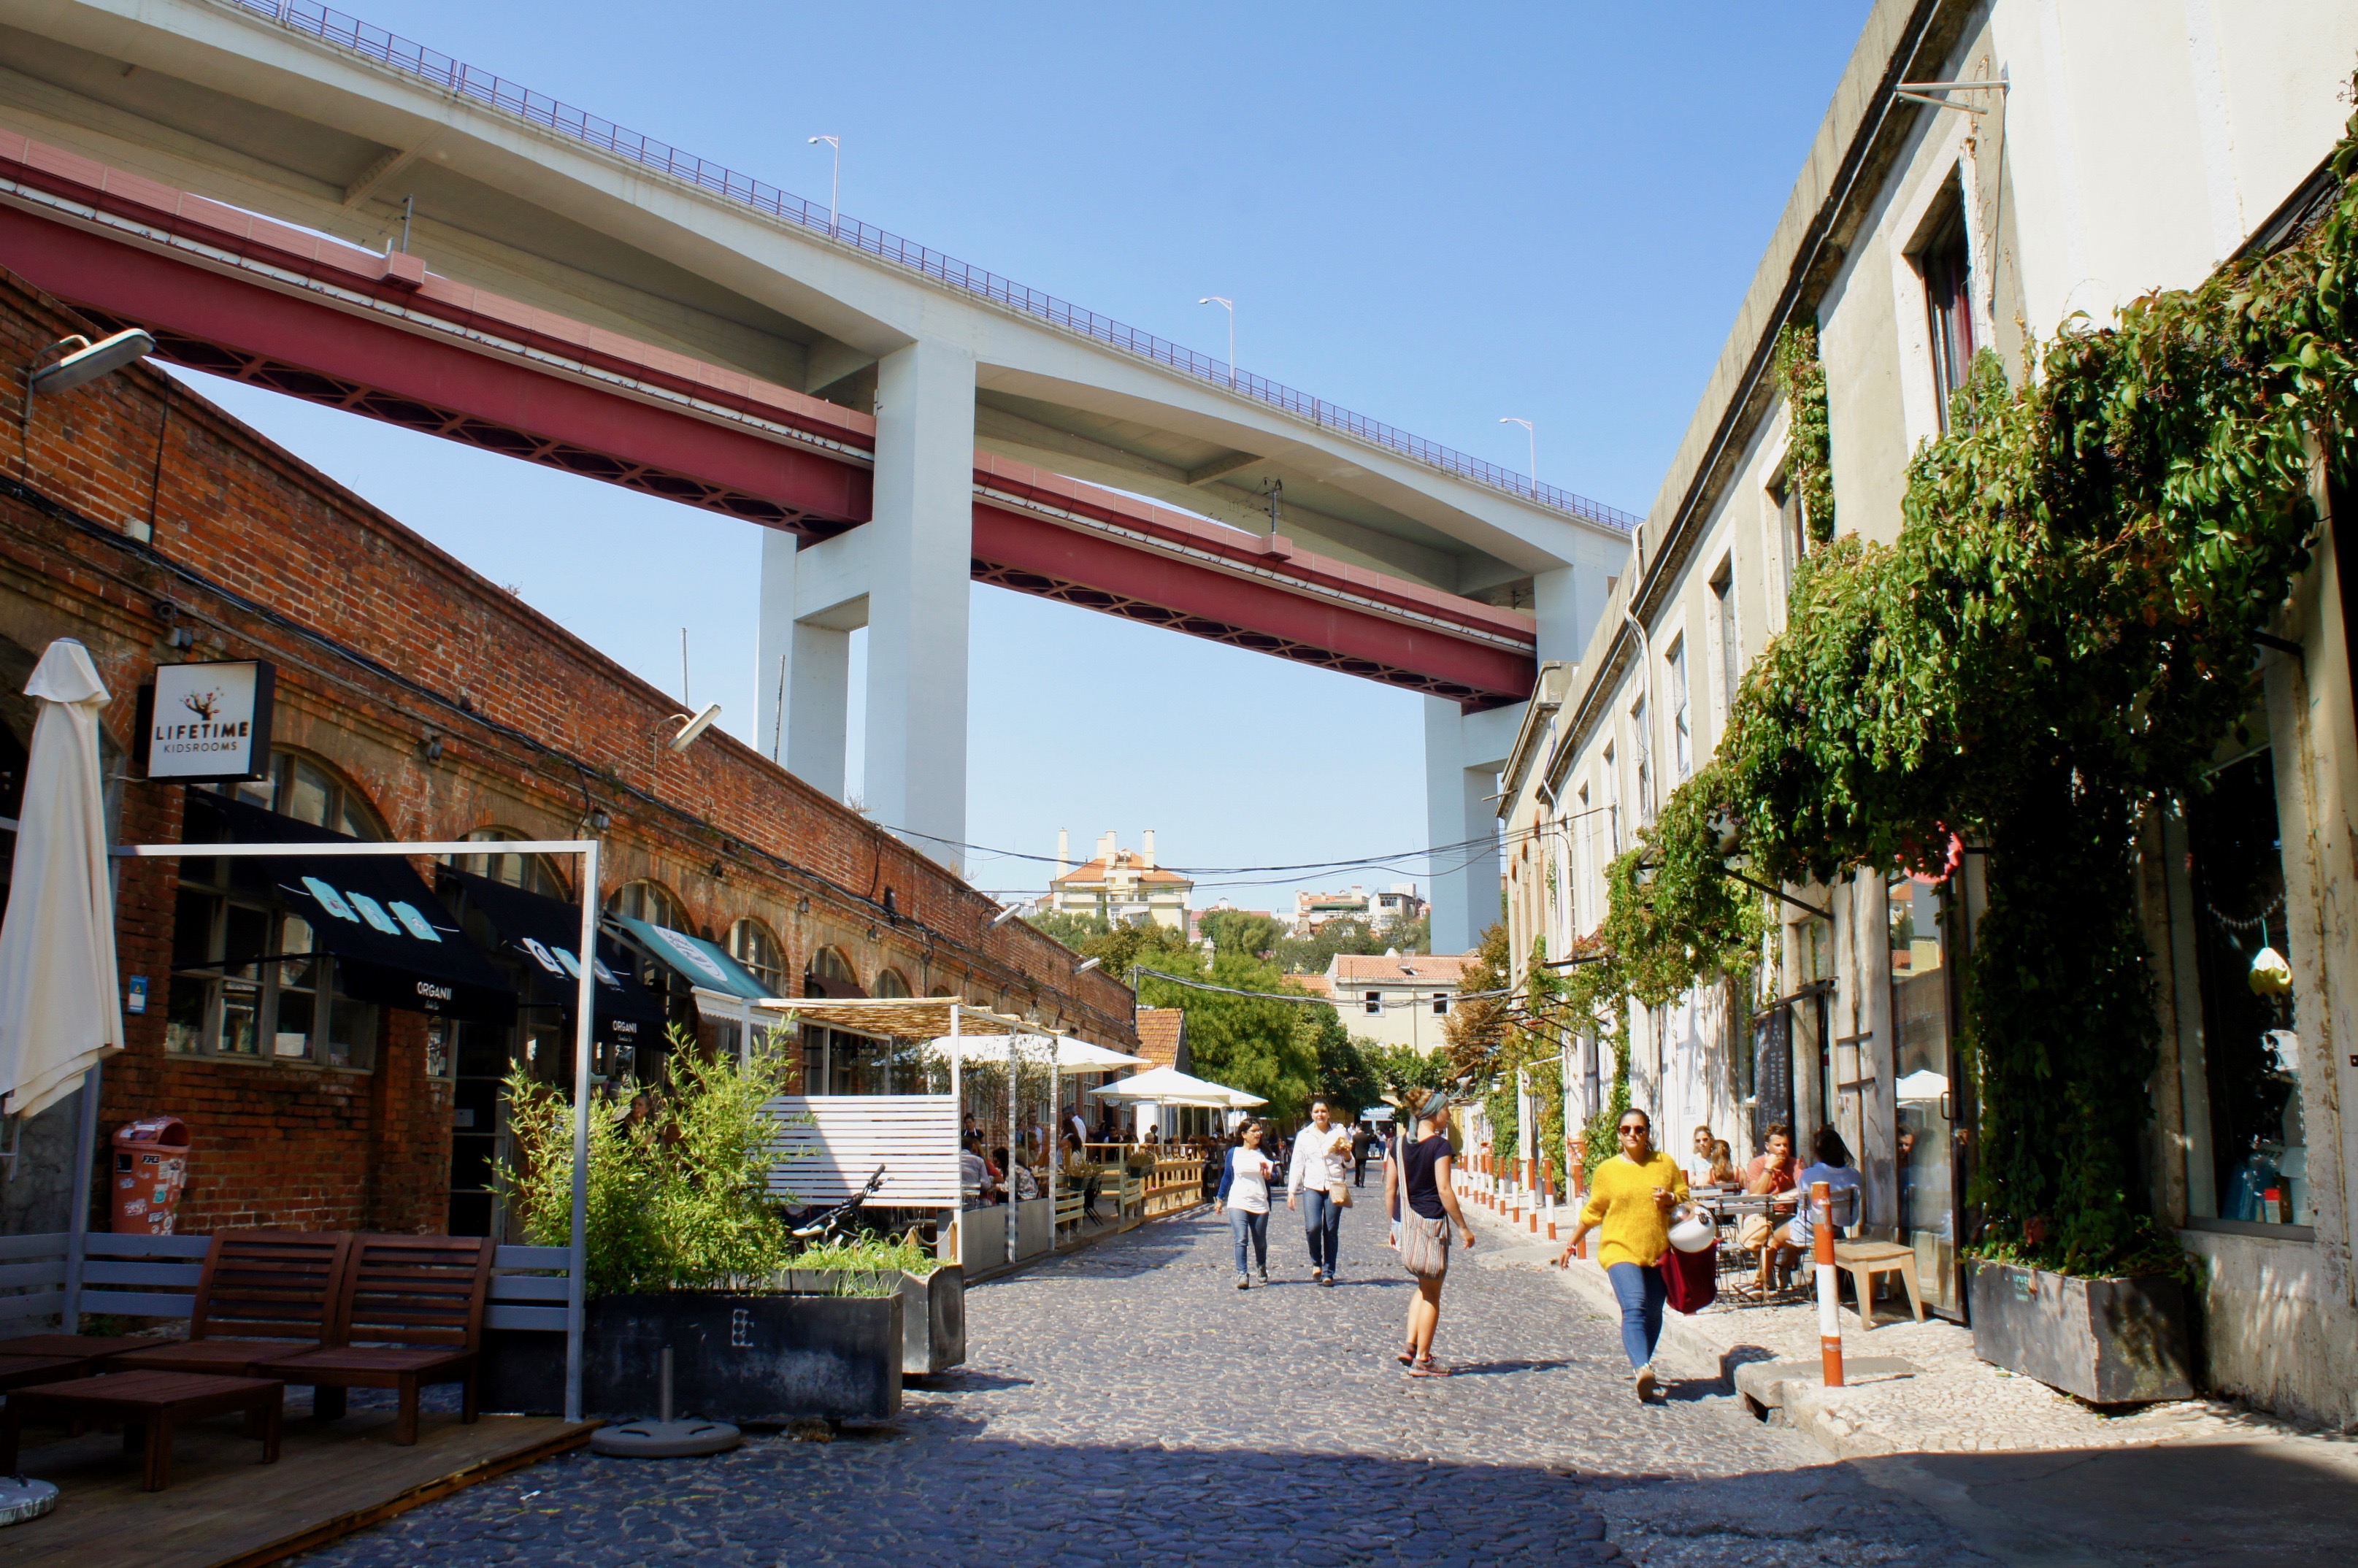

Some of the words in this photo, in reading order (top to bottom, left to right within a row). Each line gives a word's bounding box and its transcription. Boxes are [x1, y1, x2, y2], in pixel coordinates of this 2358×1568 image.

[155, 721, 250, 741] LIFETIME
[164, 742, 238, 753] KIDSROOMS
[417, 981, 452, 1001] ORGANII
[612, 1020, 637, 1034] ORGANII
